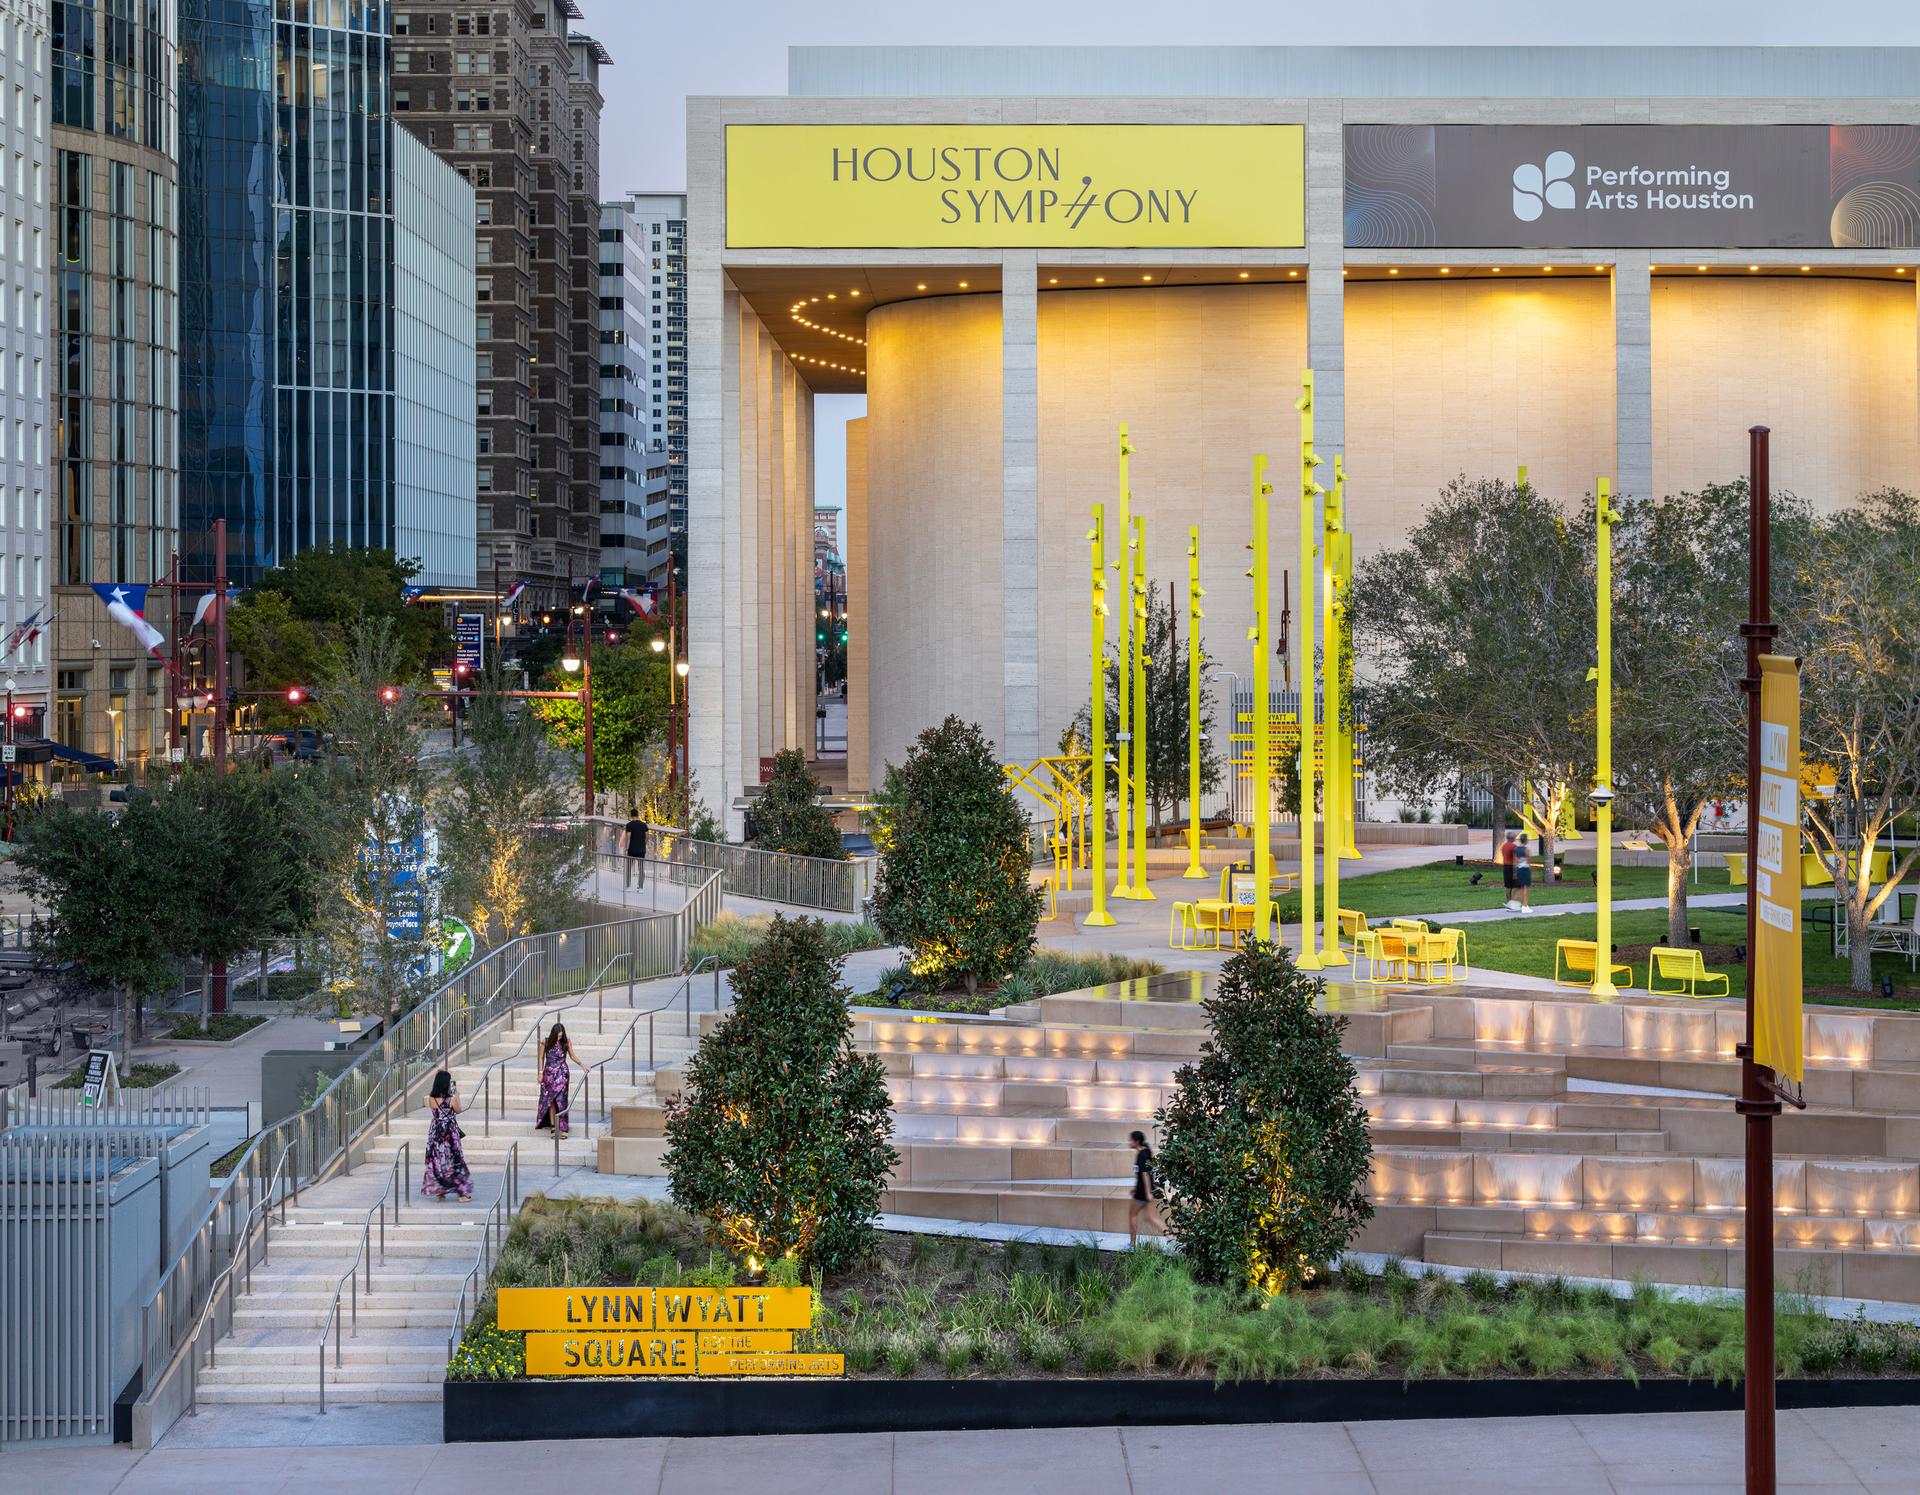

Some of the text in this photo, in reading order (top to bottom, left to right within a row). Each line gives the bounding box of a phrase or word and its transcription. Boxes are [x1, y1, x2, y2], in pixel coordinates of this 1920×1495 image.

[832, 147, 1060, 182] HOUSTON
[1585, 166, 1731, 188] Performing
[940, 175, 1199, 229] SYMPHONY
[1585, 190, 1754, 210] Arts Houston
[446, 932, 467, 957] 7
[566, 1295, 769, 1323] LYNN WYATT
[563, 1335, 752, 1368] SQUARE FOR THE
[730, 1358, 840, 1371] PERFORMING ARTS
